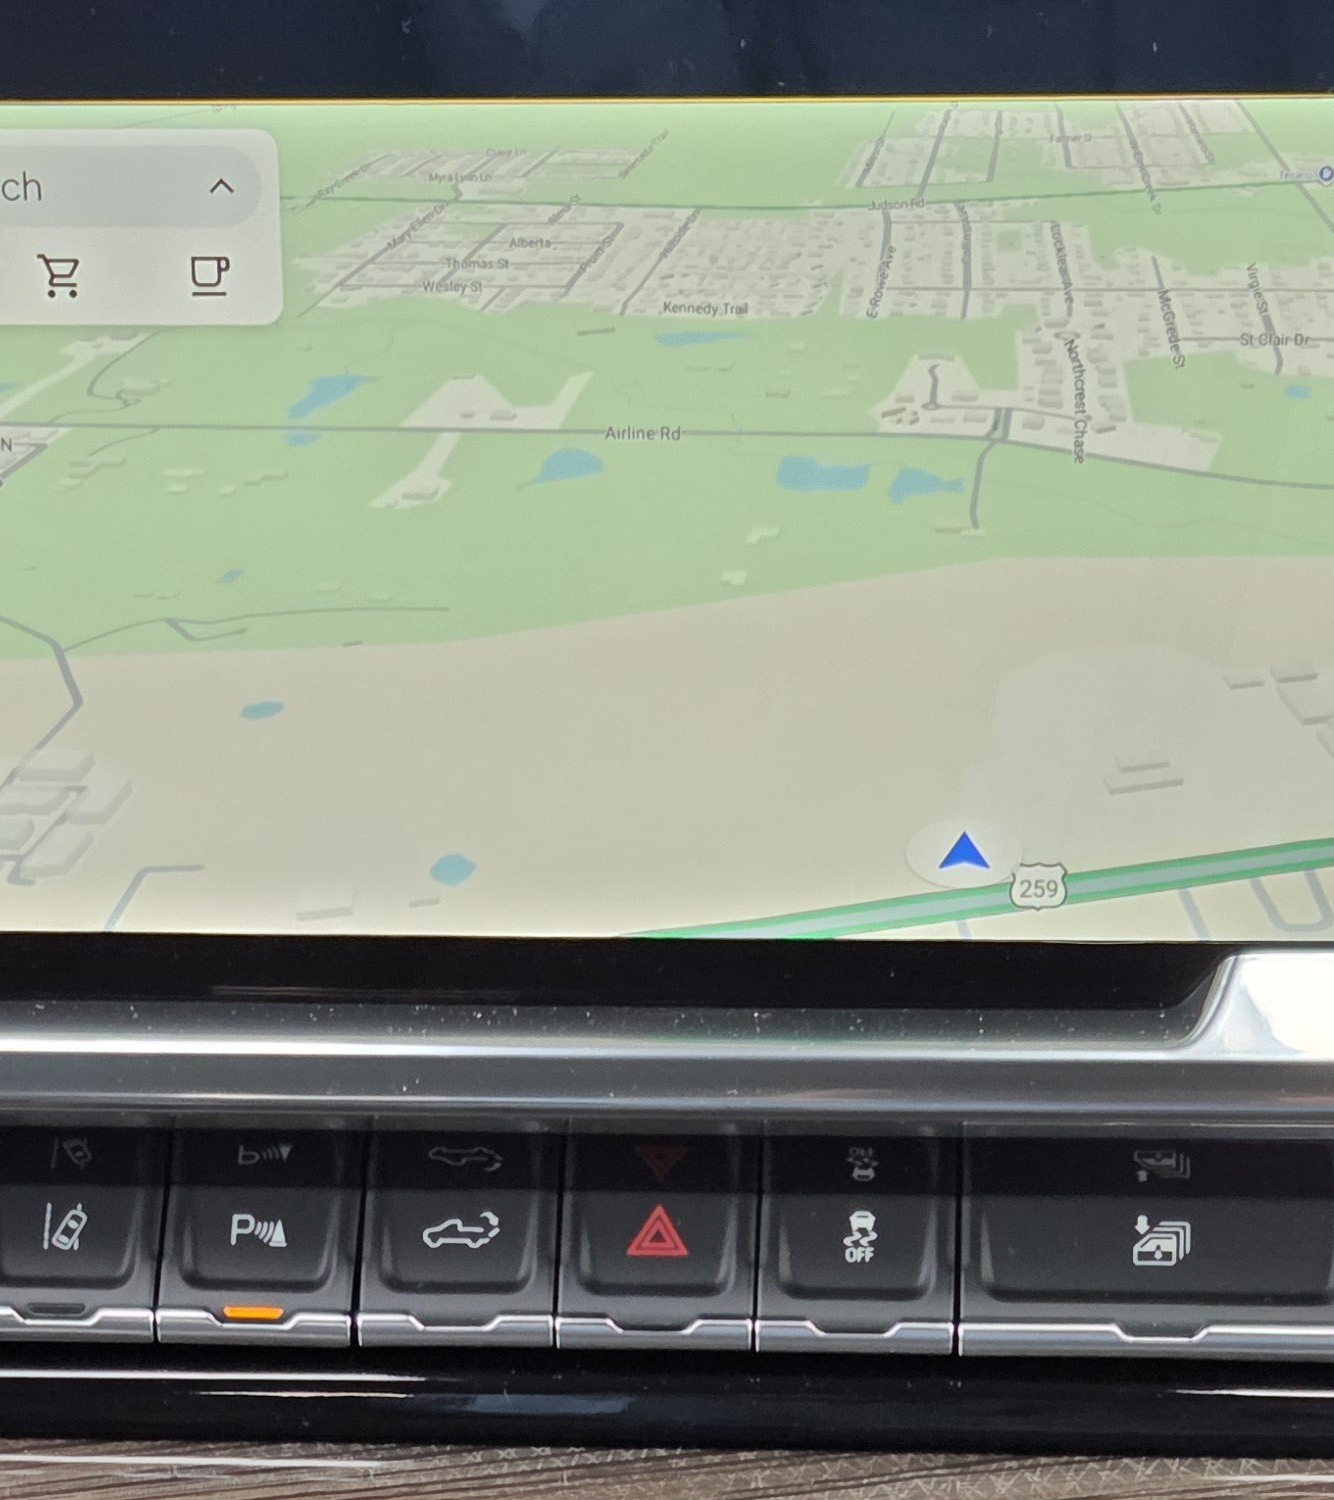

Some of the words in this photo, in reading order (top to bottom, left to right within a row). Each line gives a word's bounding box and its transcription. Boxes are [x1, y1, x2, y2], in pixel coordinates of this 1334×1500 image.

[868, 199, 909, 211] Judson
[387, 229, 413, 250] Mary
[509, 237, 552, 249] Alberta
[445, 257, 495, 270] Thomas
[497, 258, 510, 270] St
[881, 244, 897, 272] Ave
[422, 280, 467, 295] Wesley
[470, 281, 483, 292] St
[869, 270, 890, 310] Rowe
[1062, 281, 1075, 305] Ave
[663, 301, 719, 317] Kennedy
[723, 302, 749, 314] Trail
[866, 309, 878, 320] E
[1240, 333, 1255, 346] St
[1258, 333, 1292, 346] Clair
[1294, 333, 1310, 346] Dr
[1172, 353, 1186, 369] St
[1064, 338, 1087, 416] Northcrest
[604, 424, 657, 442] Airline
[659, 424, 682, 442] Rd
[0, 437, 14, 452] N
[1073, 419, 1088, 464] Chase
[1018, 878, 1059, 902] 259
[844, 1246, 875, 1263] OFF
